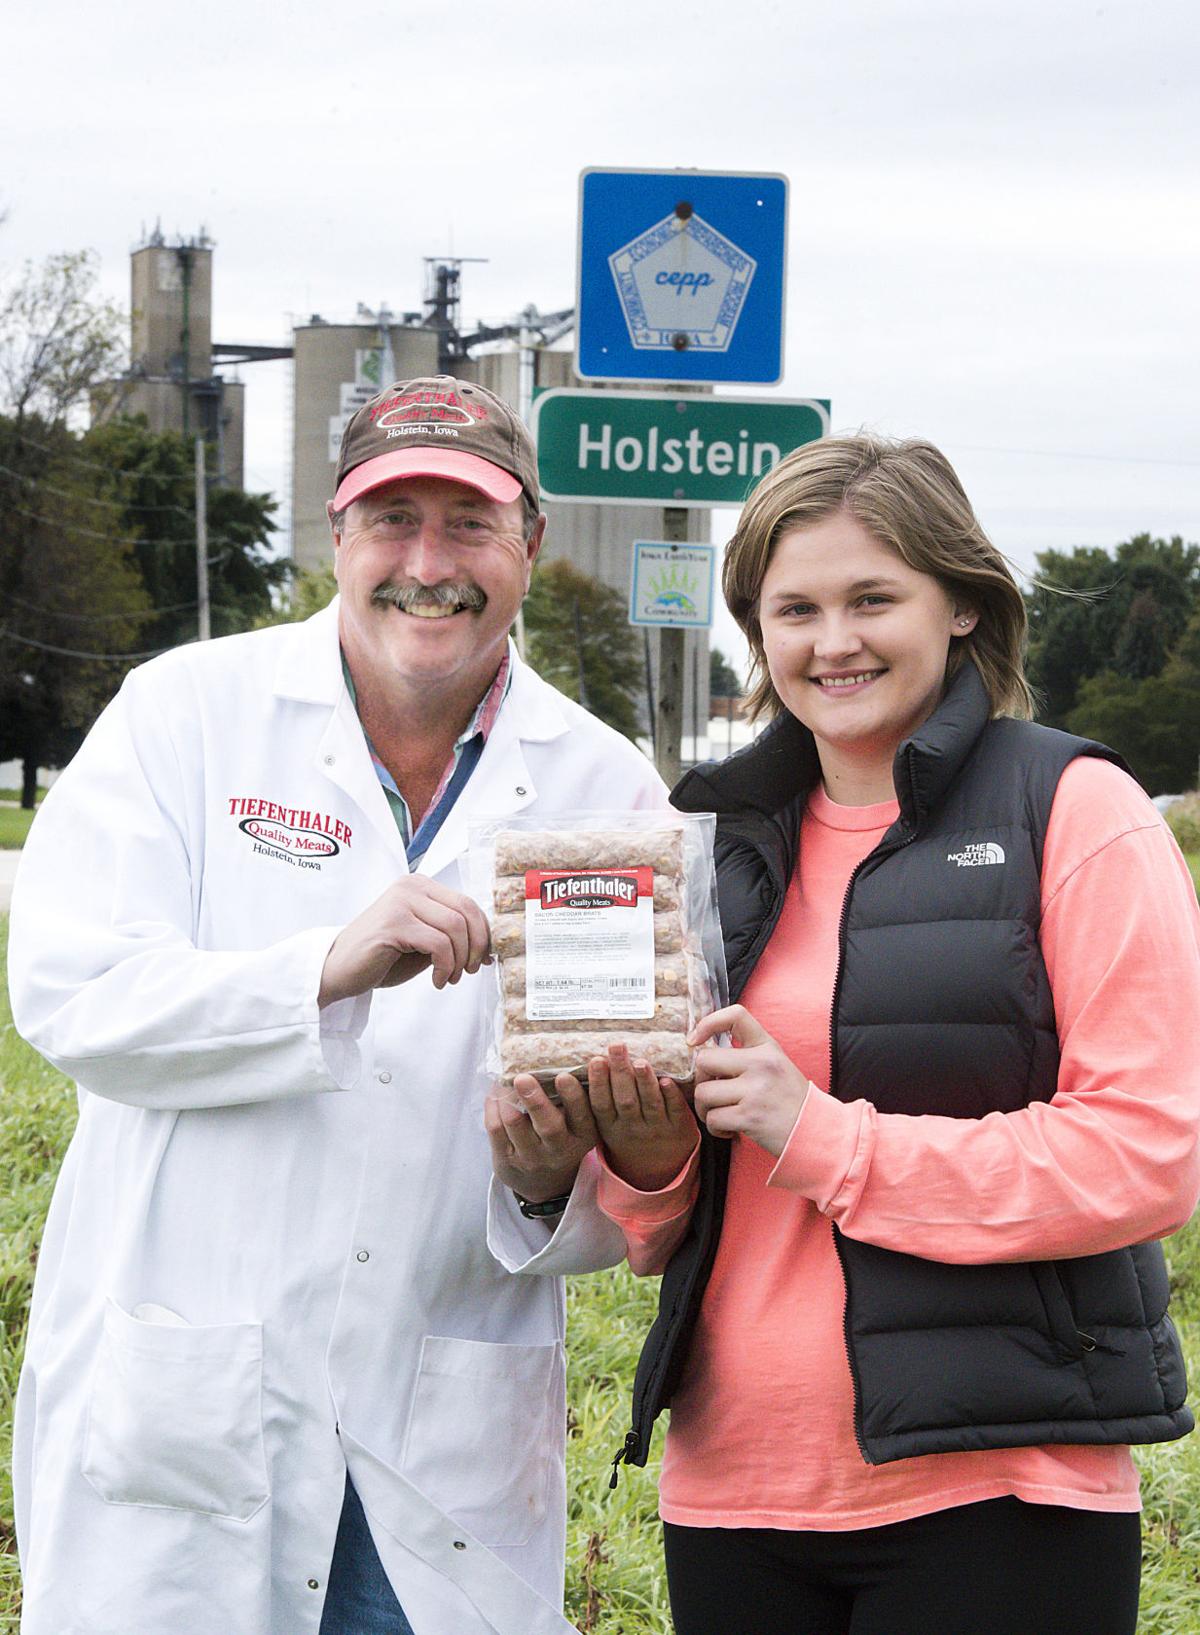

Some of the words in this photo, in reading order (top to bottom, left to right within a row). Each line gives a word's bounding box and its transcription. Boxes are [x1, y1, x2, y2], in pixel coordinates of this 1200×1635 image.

[656, 271, 715, 296] cepp
[659, 332, 702, 345] IOA
[386, 426, 431, 440] Holstein,
[433, 425, 459, 437] Iowa
[578, 423, 781, 477] Holstein
[228, 798, 352, 848] TIEFENTHALER
[248, 821, 292, 847] Quality
[295, 837, 332, 853] Meats
[253, 843, 296, 866] Holstein,
[298, 858, 321, 871] Iowa
[947, 851, 986, 861] NORTH
[965, 843, 987, 852] THE
[957, 858, 986, 867] FACE
[544, 877, 634, 904] Tiefenthaler
[569, 899, 592, 908] Quality
